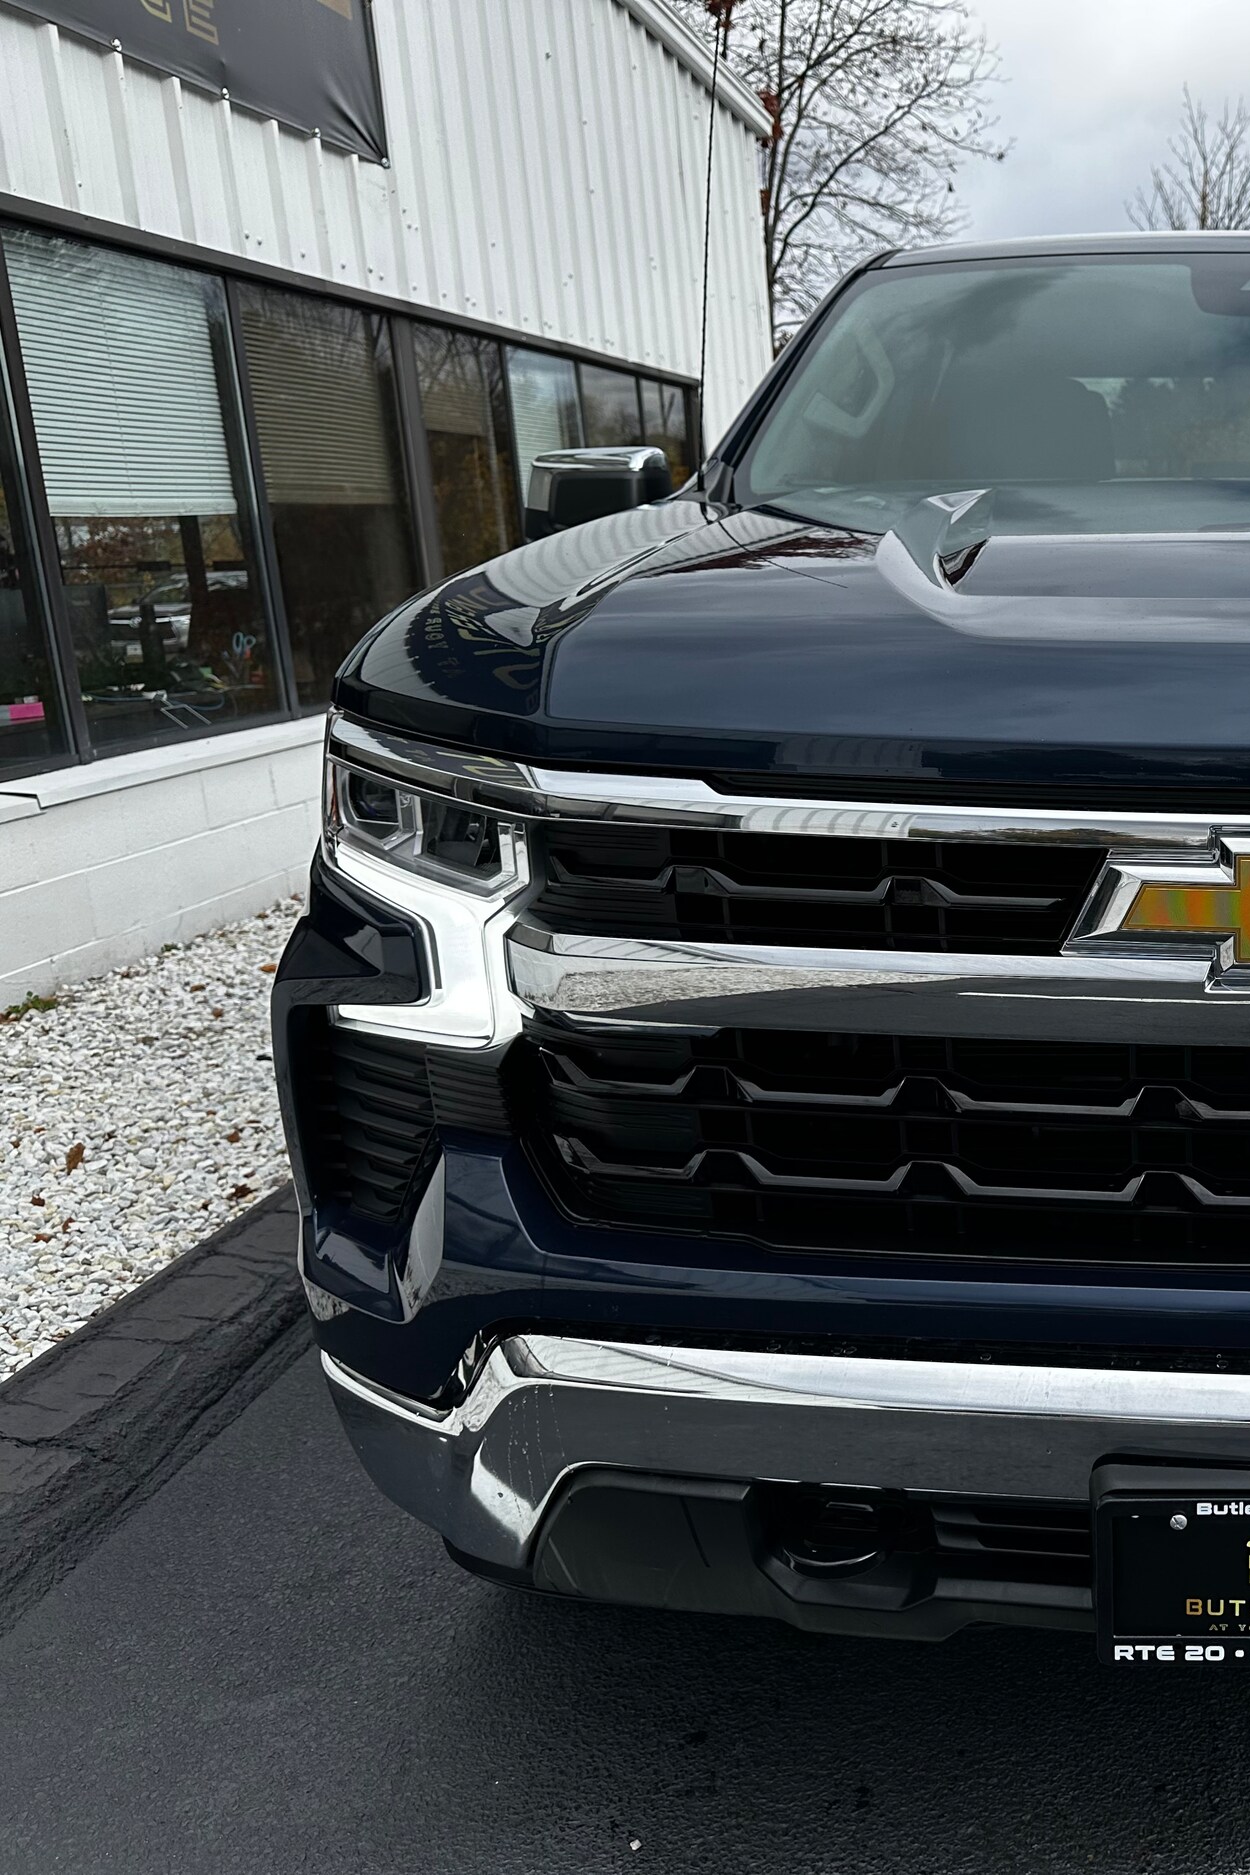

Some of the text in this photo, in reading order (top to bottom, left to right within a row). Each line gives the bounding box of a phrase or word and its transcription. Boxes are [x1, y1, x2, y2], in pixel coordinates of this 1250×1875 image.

[1208, 1623, 1229, 1632] AT
[1114, 1645, 1176, 1661] RTE
[1184, 1645, 1225, 1662] 20
